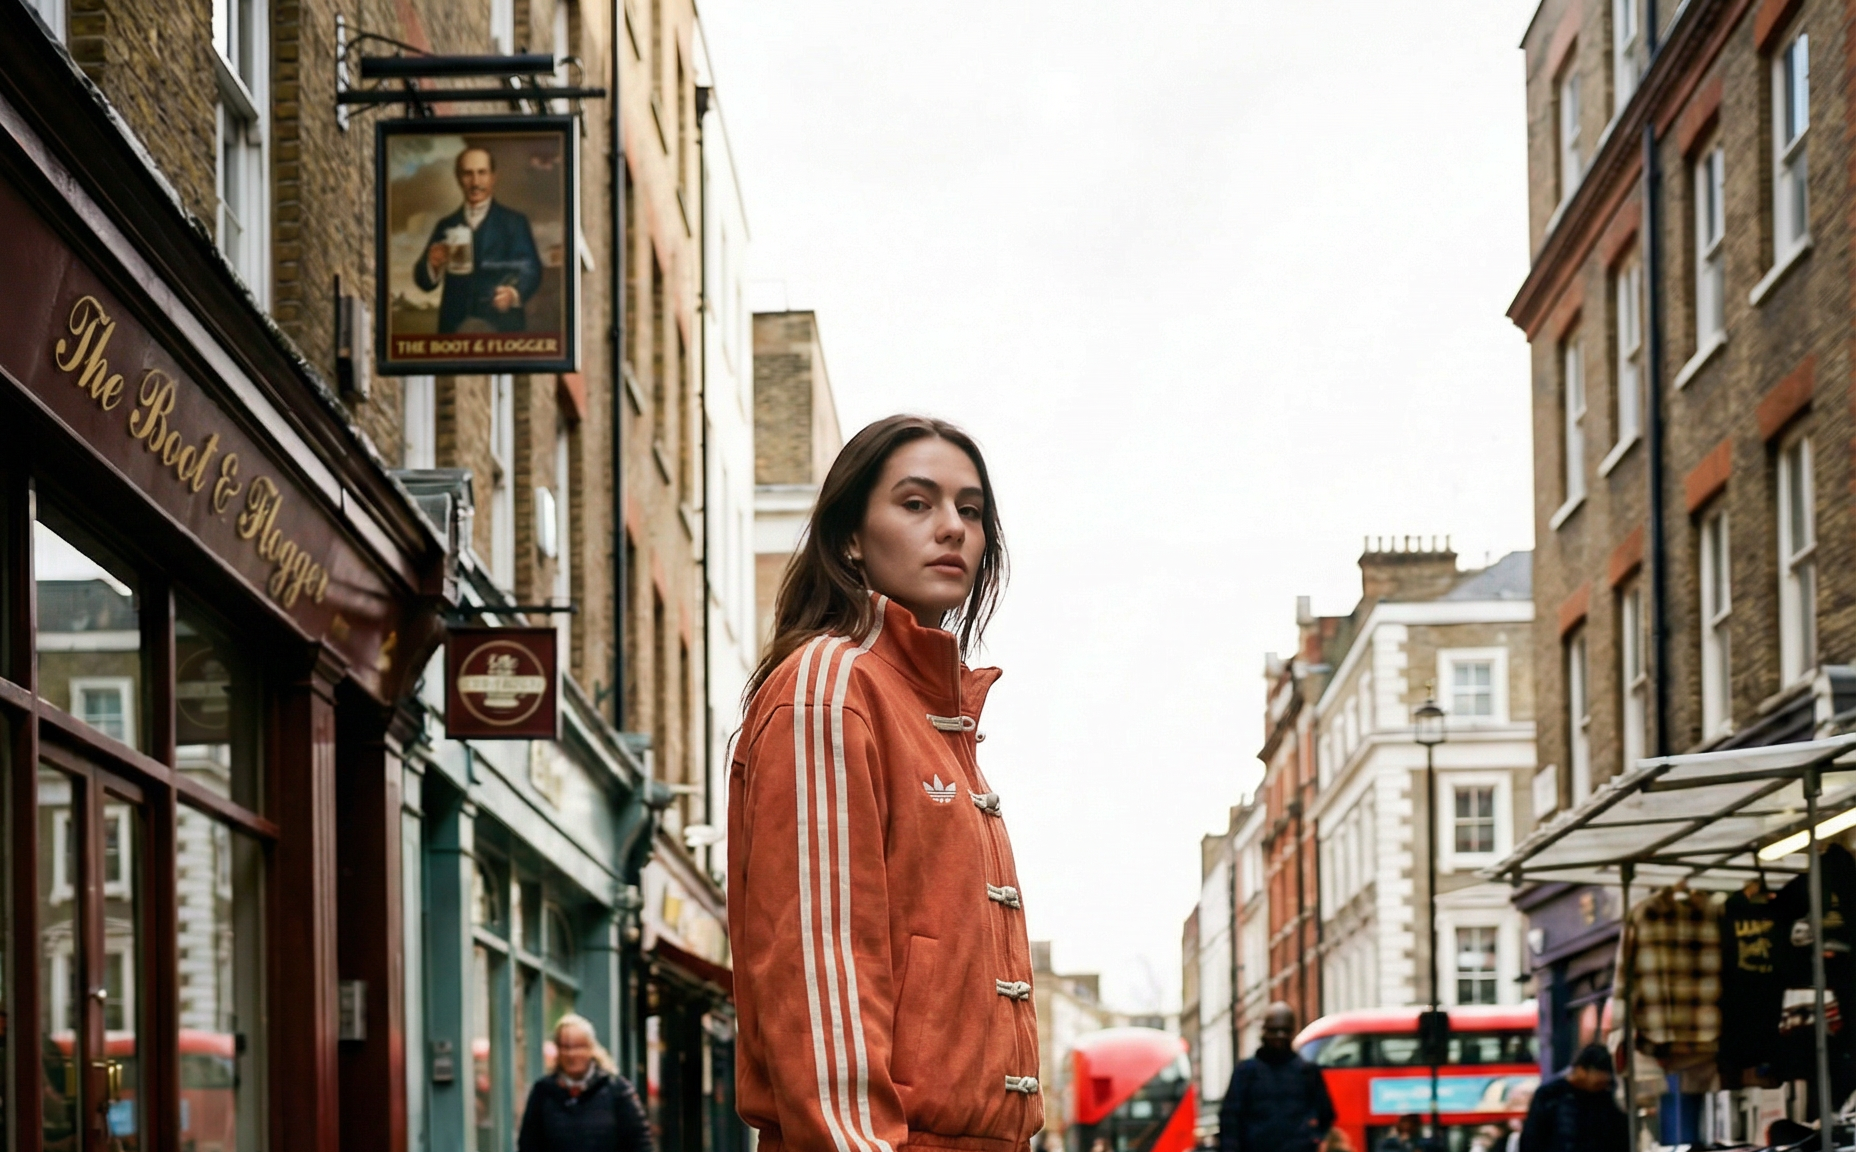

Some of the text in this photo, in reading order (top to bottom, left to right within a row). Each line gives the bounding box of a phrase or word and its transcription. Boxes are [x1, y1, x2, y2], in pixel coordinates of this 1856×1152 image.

[396, 338, 558, 354] THE BOOT & FLOGGER
[56, 295, 329, 609] The Boot & Flogger
